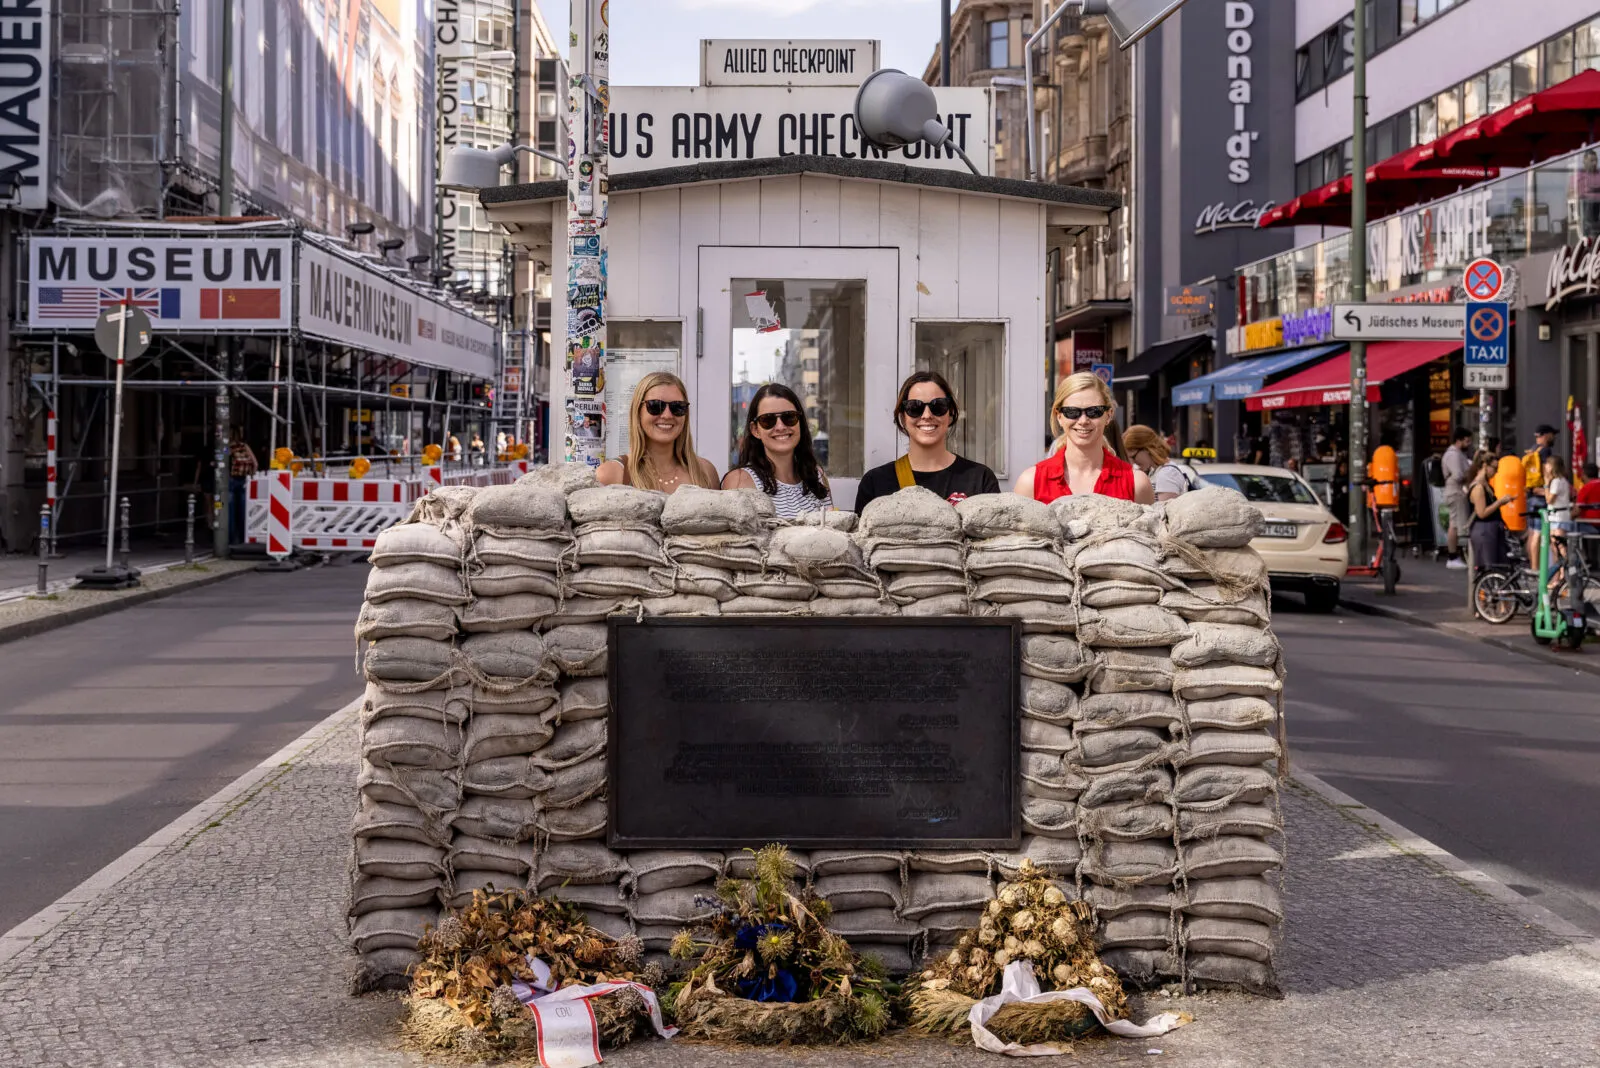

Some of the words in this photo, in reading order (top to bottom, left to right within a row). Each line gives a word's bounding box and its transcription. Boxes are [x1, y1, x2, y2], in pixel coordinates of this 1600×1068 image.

[724, 49, 766, 73] ALLIED
[773, 48, 856, 73] CHECKPOINT
[1225, 2, 1258, 183] Donald's
[609, 113, 653, 159] US
[672, 113, 762, 159] ARMY
[1196, 199, 1275, 231] McCaf
[1436, 189, 1493, 267] COFFEE
[38, 247, 281, 281] MUSEUM
[310, 261, 413, 346] MAUERMUSEUM
[1368, 315, 1418, 328] Jüdisches
[1422, 316, 1464, 328] Museum
[1469, 346, 1504, 360] TAXI
[1470, 372, 1476, 382] 5
[1478, 372, 1503, 382] Taxen
